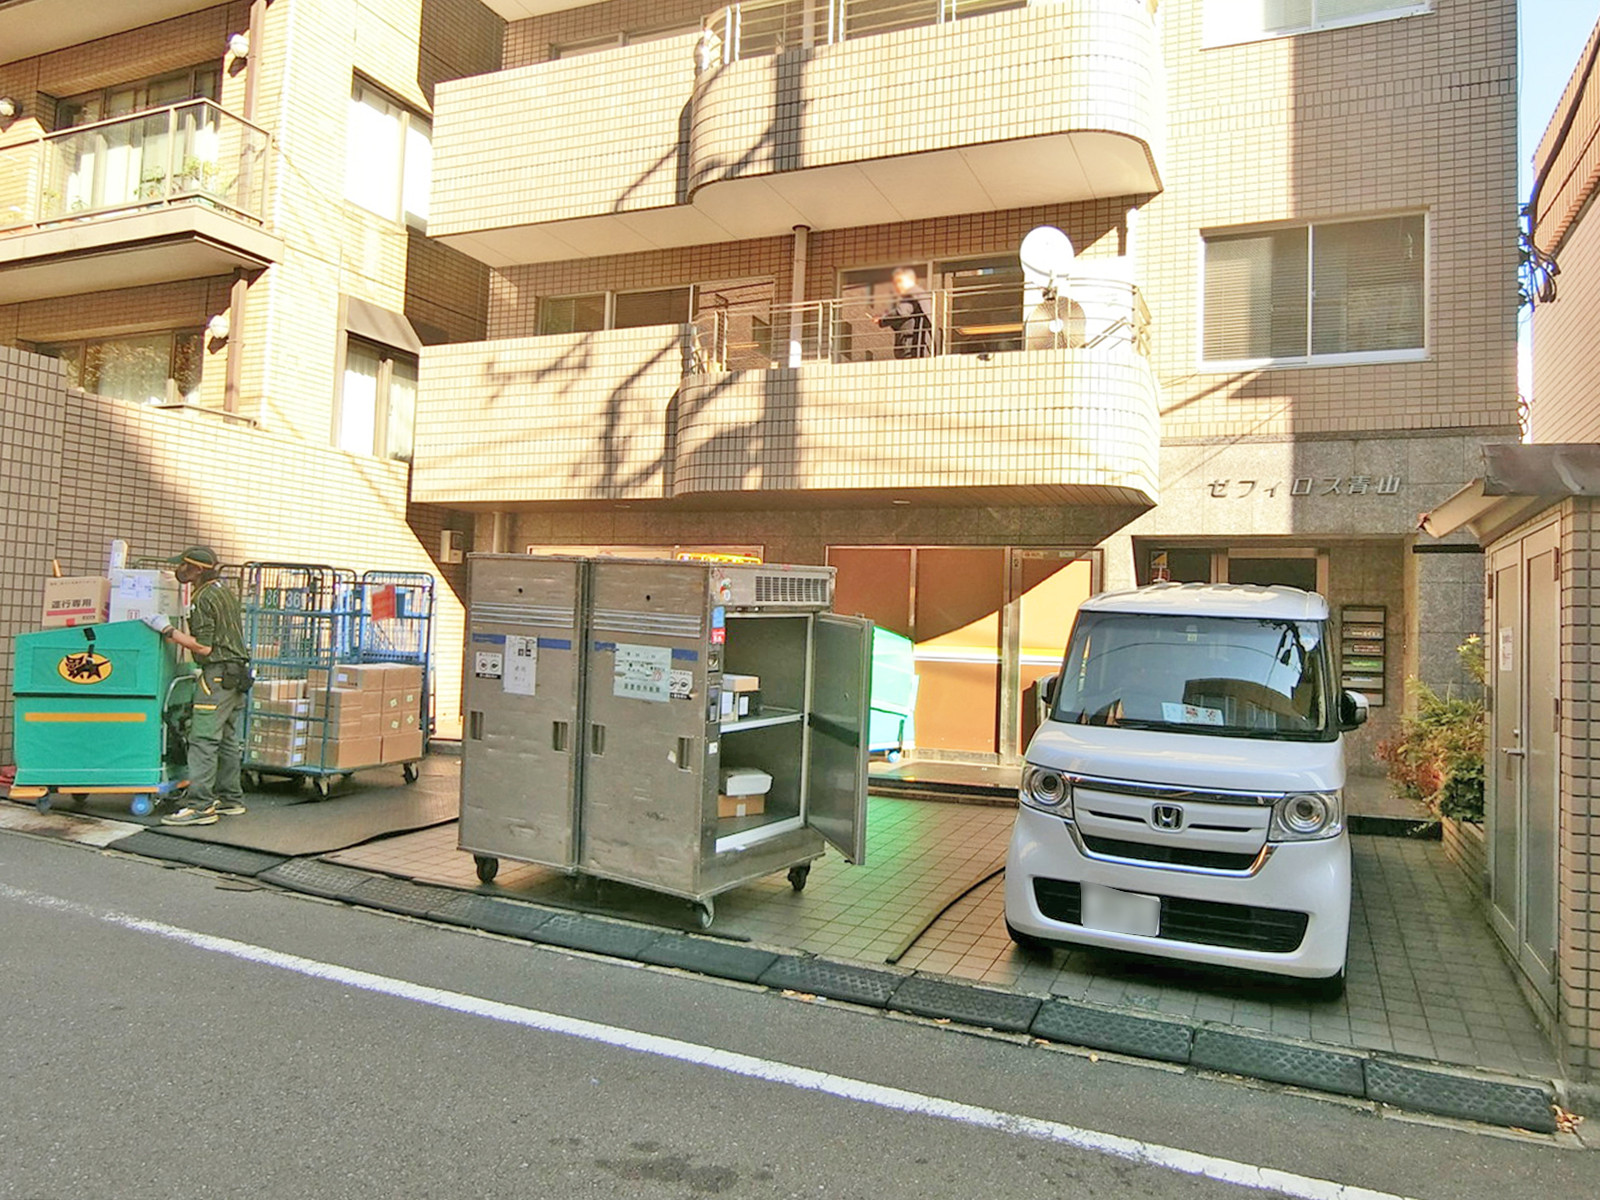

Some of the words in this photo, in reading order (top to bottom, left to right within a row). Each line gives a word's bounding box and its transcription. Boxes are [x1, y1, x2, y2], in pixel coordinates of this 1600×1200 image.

[1207, 475, 1401, 499] ゼフィロス青山
